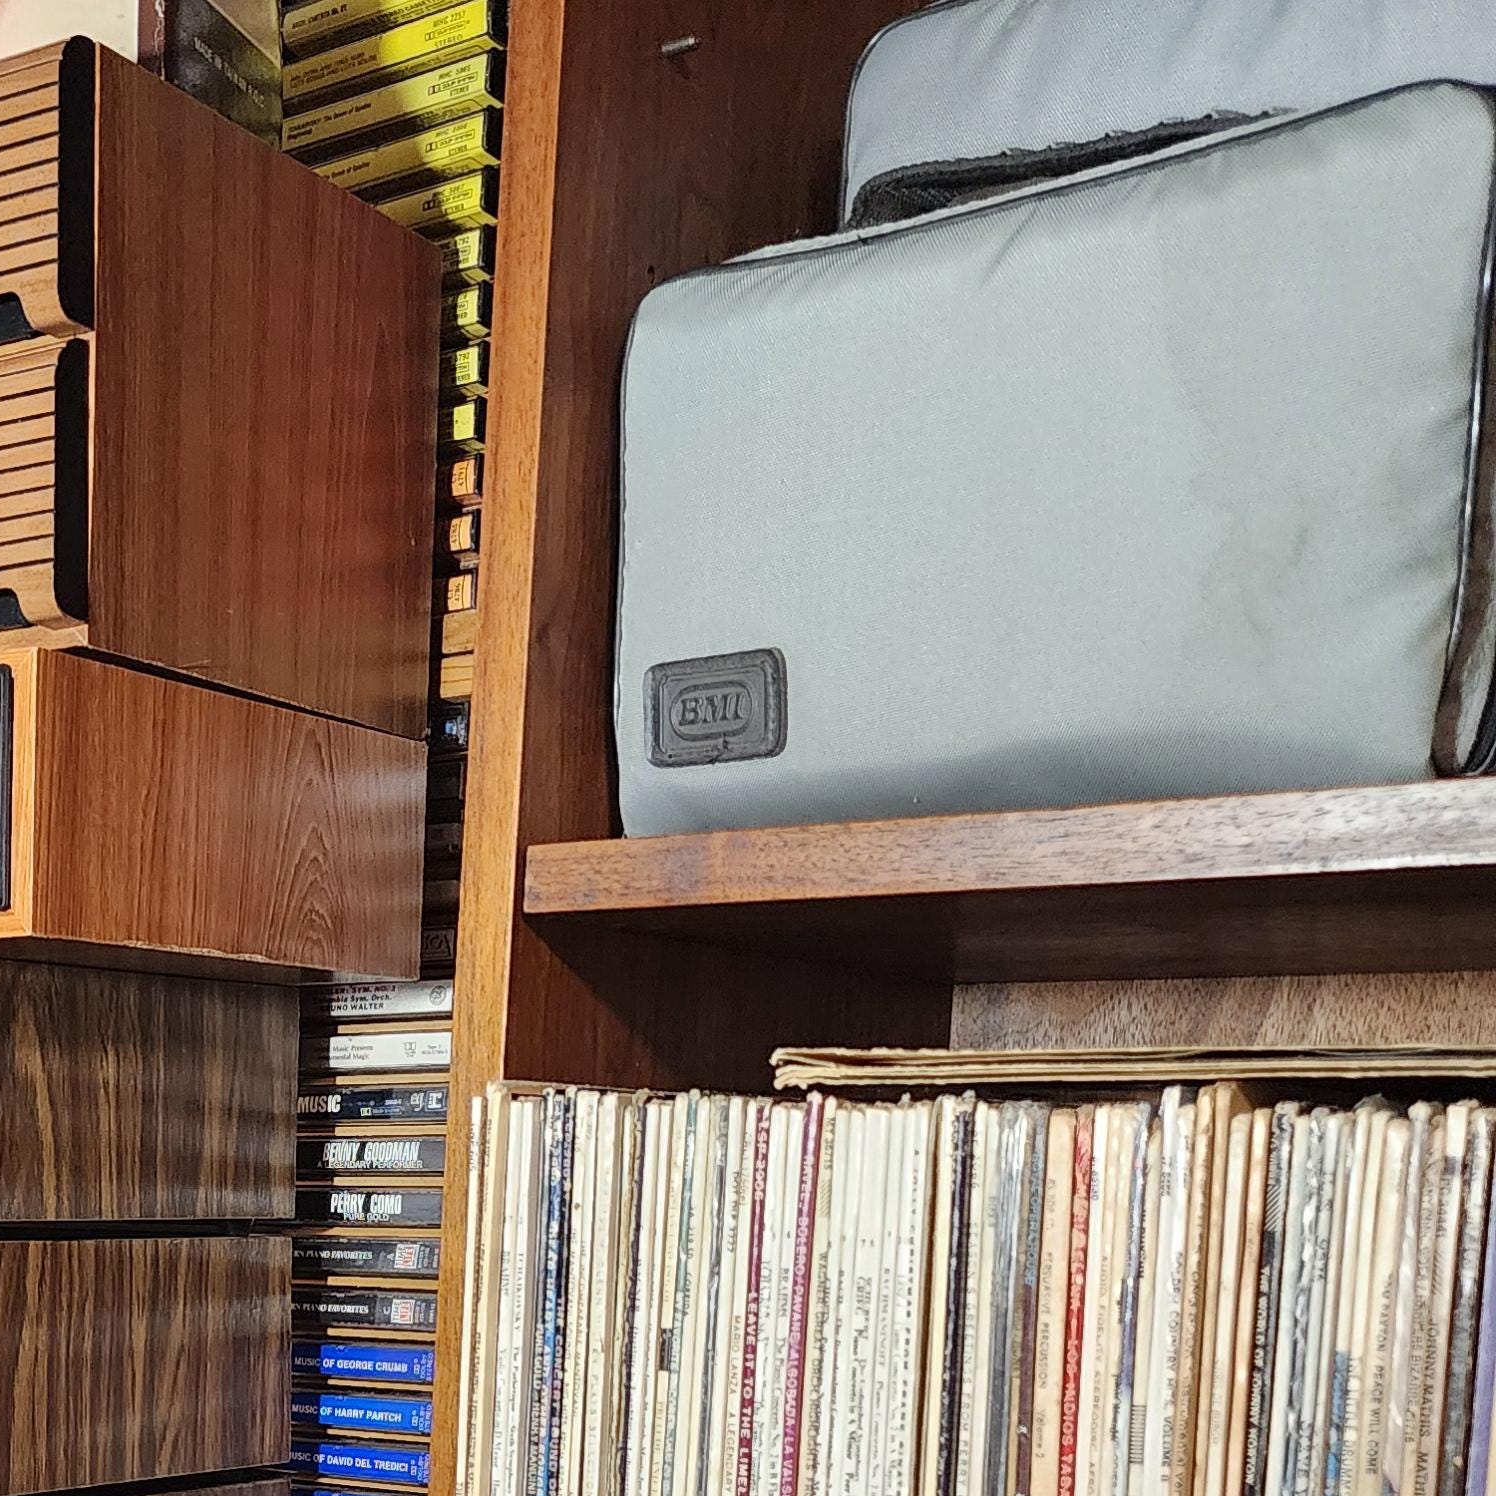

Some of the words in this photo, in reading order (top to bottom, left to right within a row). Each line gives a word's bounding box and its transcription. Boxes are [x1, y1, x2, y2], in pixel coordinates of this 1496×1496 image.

[678, 692, 745, 726] BMI
[297, 1094, 342, 1113] MUSIC
[322, 1141, 361, 1161] BENNY
[364, 1141, 420, 1161] GOODMAN
[330, 1194, 365, 1214] PERRY
[369, 1194, 402, 1214] COMO
[1041, 1252, 1053, 1315] PERSUASIVE
[294, 1356, 320, 1366] MUSIC
[322, 1359, 335, 1368] OF
[337, 1360, 373, 1371] GEORGE
[376, 1362, 408, 1373] CRUMB
[1038, 1322, 1051, 1389] PERCUSSION
[725, 1421, 735, 1492] LEGENDARY
